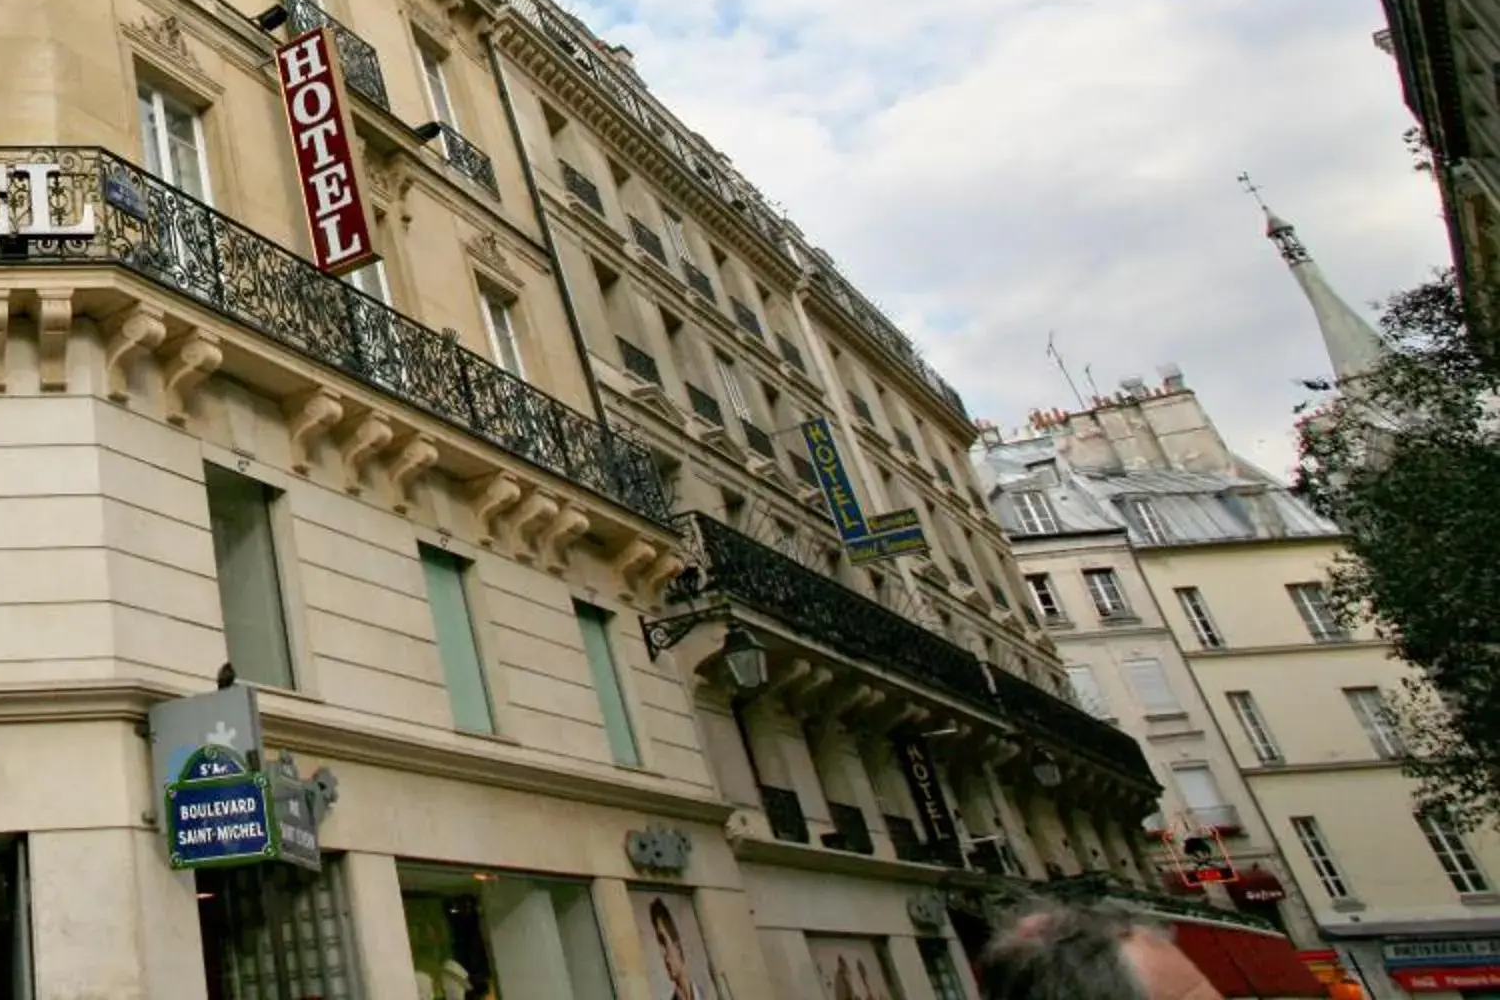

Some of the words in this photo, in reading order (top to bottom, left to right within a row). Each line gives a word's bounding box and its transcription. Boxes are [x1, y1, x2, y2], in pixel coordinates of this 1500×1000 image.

[280, 34, 361, 264] HOTEL
[179, 798, 256, 820] BOULEVARD
[178, 823, 265, 845] SAINT-MICHEL
